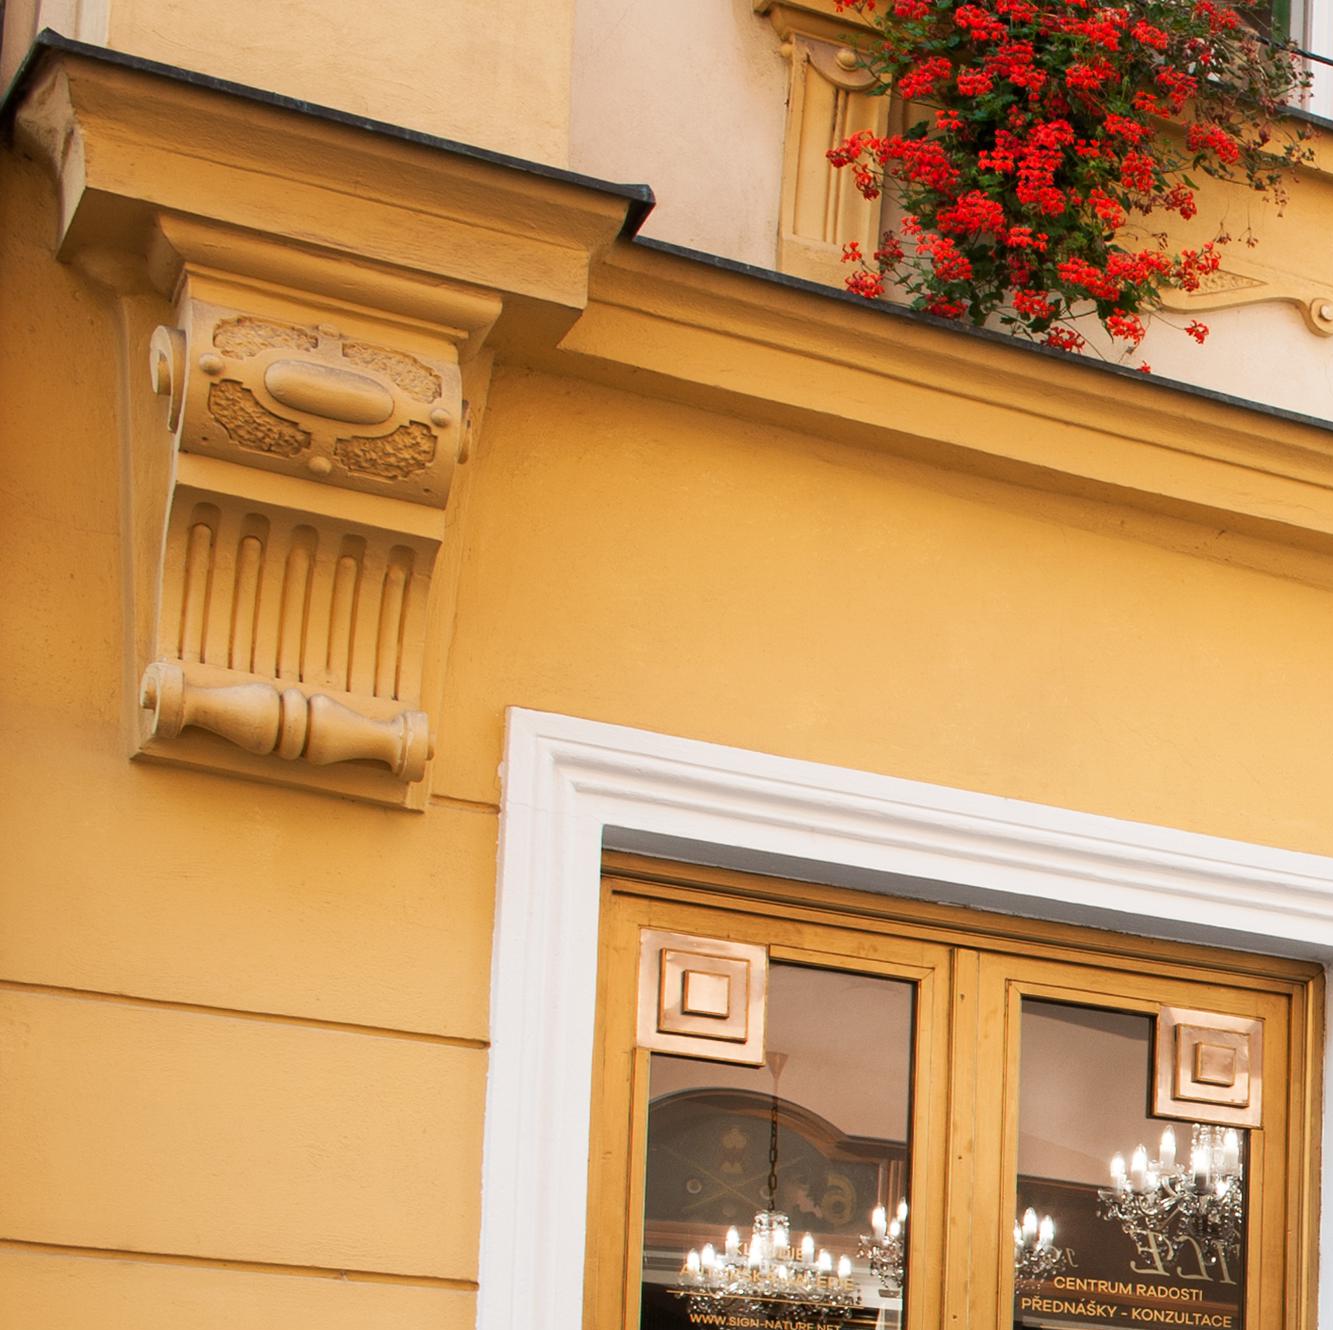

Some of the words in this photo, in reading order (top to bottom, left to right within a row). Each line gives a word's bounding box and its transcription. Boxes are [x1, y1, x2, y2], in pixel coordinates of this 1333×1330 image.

[1053, 1276, 1132, 1296] CENTRUM
[1135, 1284, 1203, 1302] RADOSTI
[1021, 1295, 1117, 1317] PŘEDNÁŠKY
[1131, 1307, 1233, 1328] KONZULTACE
